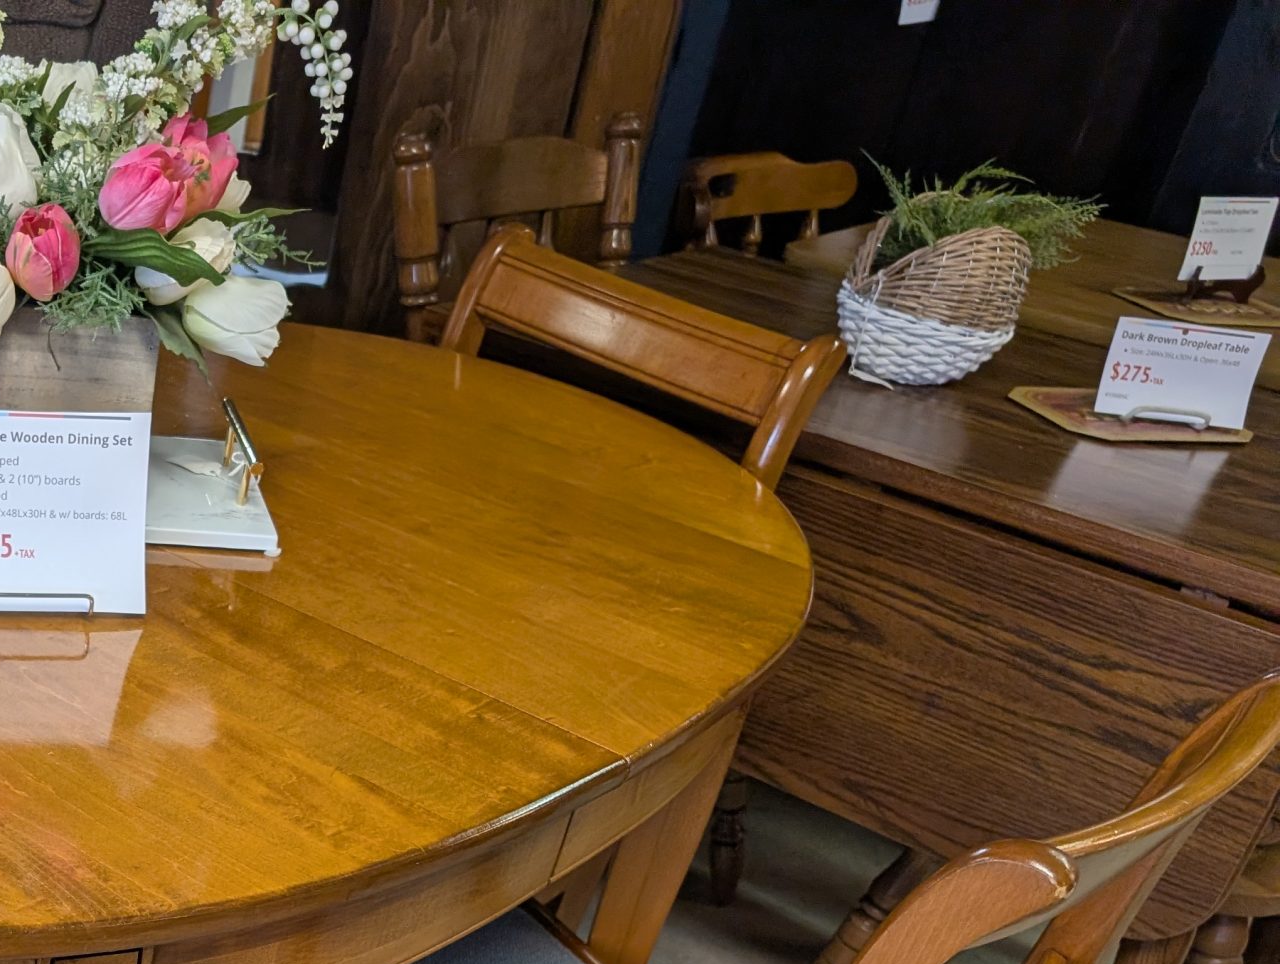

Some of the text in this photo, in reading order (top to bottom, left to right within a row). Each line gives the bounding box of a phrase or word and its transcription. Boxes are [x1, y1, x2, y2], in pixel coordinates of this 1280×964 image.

[1191, 241, 1213, 256] $250
[1122, 330, 1250, 354] Dark Brown Dropleaf Table
[1110, 361, 1152, 383] $275
[11, 431, 64, 444] Wooden
[68, 433, 109, 449] Dining
[113, 434, 133, 446] Set
[8, 474, 15, 484] 2
[44, 475, 81, 486] boards
[49, 510, 57, 519] &
[59, 510, 71, 520] w/
[73, 510, 108, 520] boards:
[110, 511, 127, 521] 68L
[15, 549, 35, 559] +TAX
